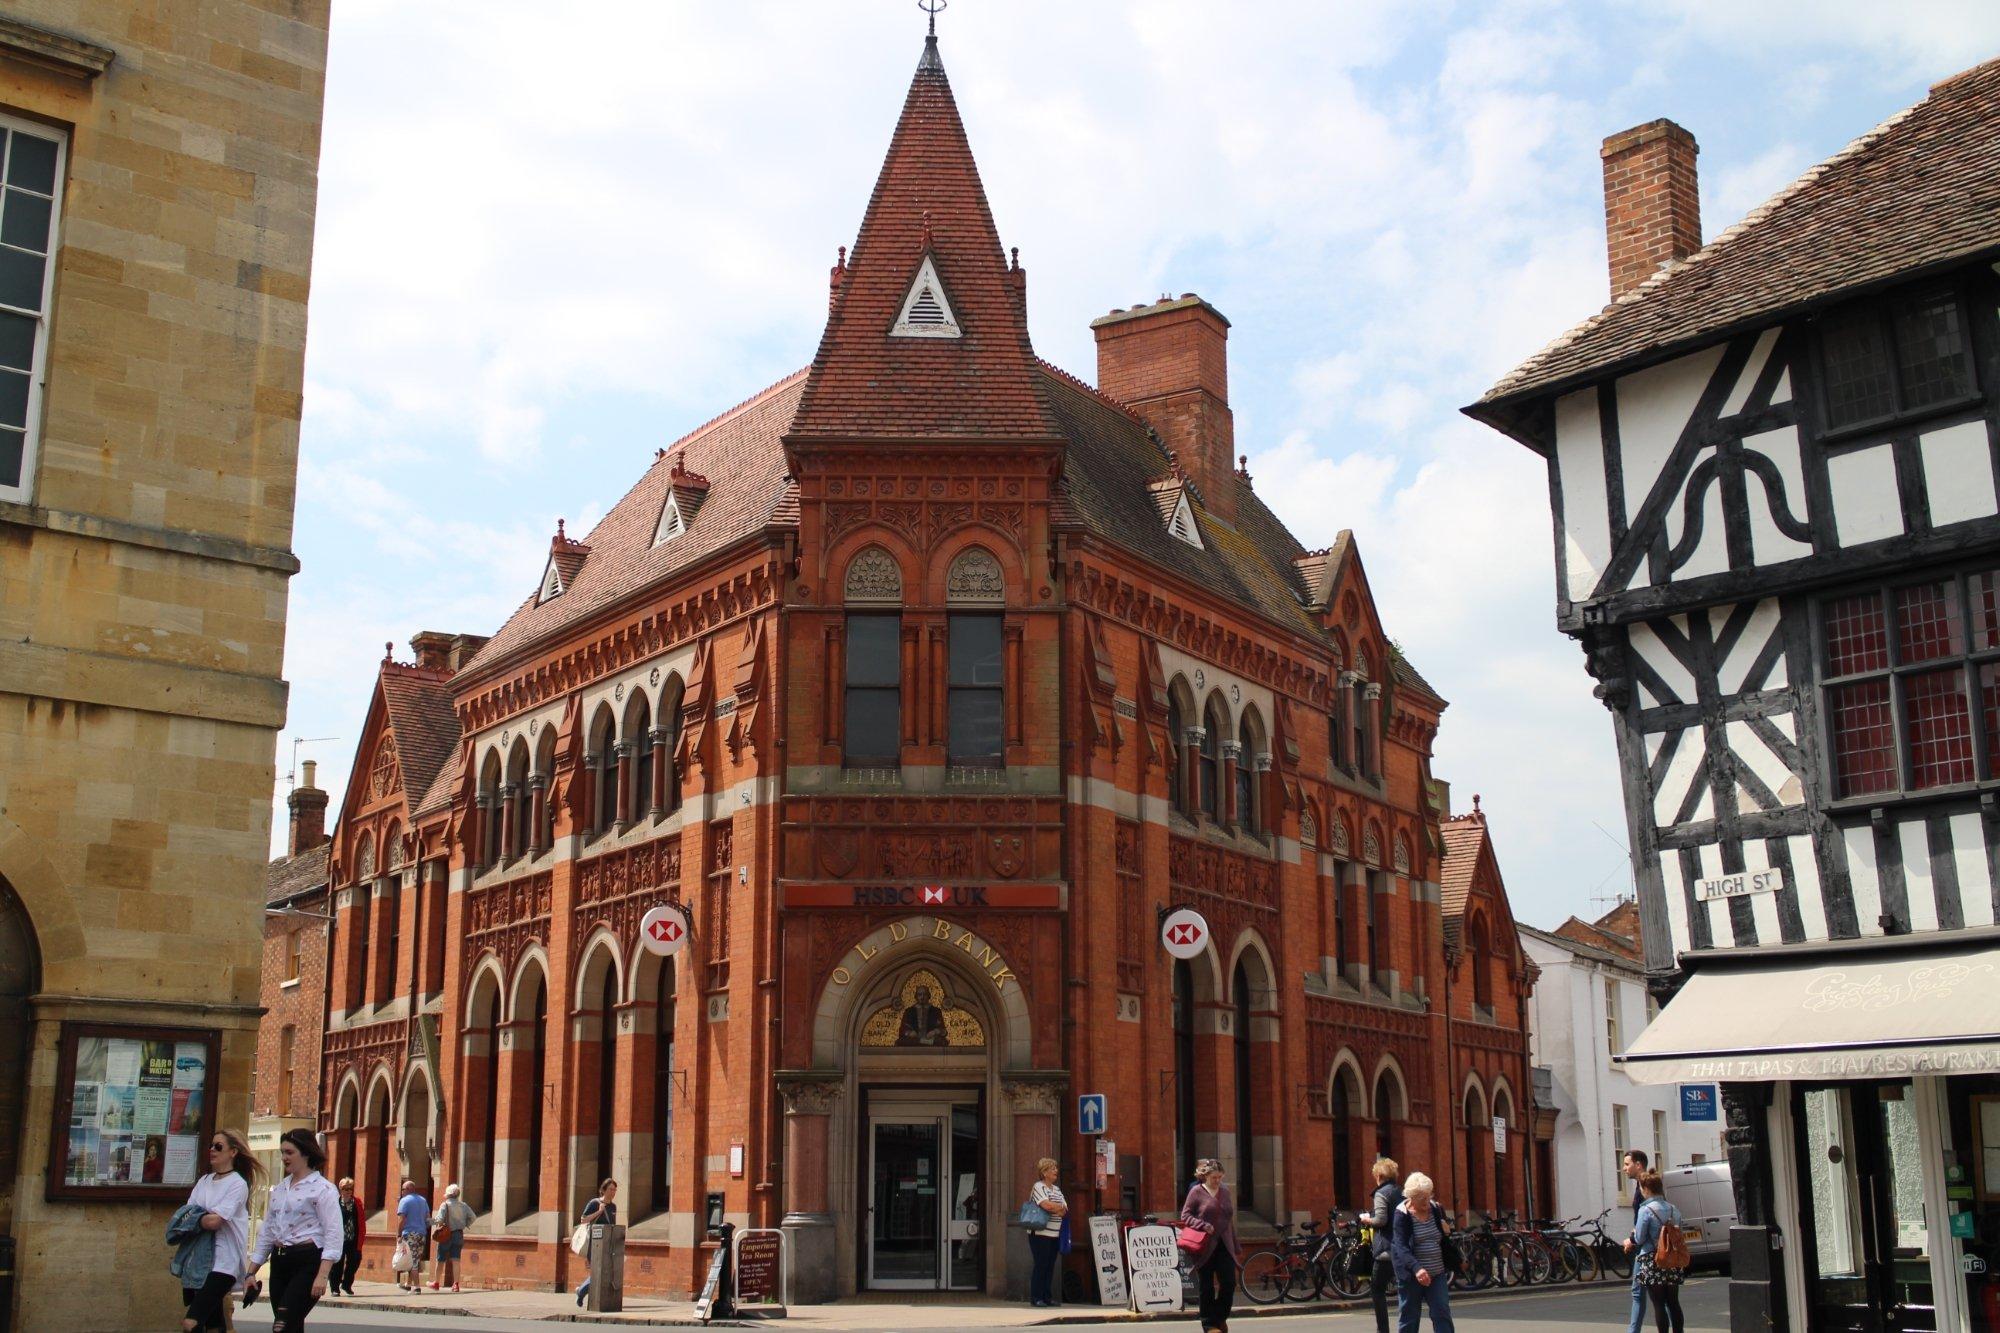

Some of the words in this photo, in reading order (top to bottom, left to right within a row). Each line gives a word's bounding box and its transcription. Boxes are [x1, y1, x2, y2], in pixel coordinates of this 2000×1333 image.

[1704, 876, 1745, 897] HIGH
[1753, 873, 1771, 890] ST
[853, 887, 915, 906] HSBC
[952, 887, 989, 906] UK
[832, 921, 908, 984] OLD
[931, 918, 1016, 989] BANK
[1691, 1062, 1732, 1077] THAI
[1738, 1059, 1794, 1076] TAPAS
[1798, 1058, 1813, 1074] &
[1821, 1055, 1866, 1074] THAI
[1872, 1050, 2000, 1073] RESTAURANT
[741, 1242, 777, 1251] Emporium
[1132, 1235, 1173, 1248] ANTIQUE
[754, 1251, 774, 1259] Room
[1135, 1247, 1172, 1259] CENTRE
[1149, 1259, 1172, 1268] STREET
[1139, 1272, 1153, 1281] OPEN
[1160, 1271, 1175, 1280] DAYS
[1151, 1281, 1169, 1289] WEEK
